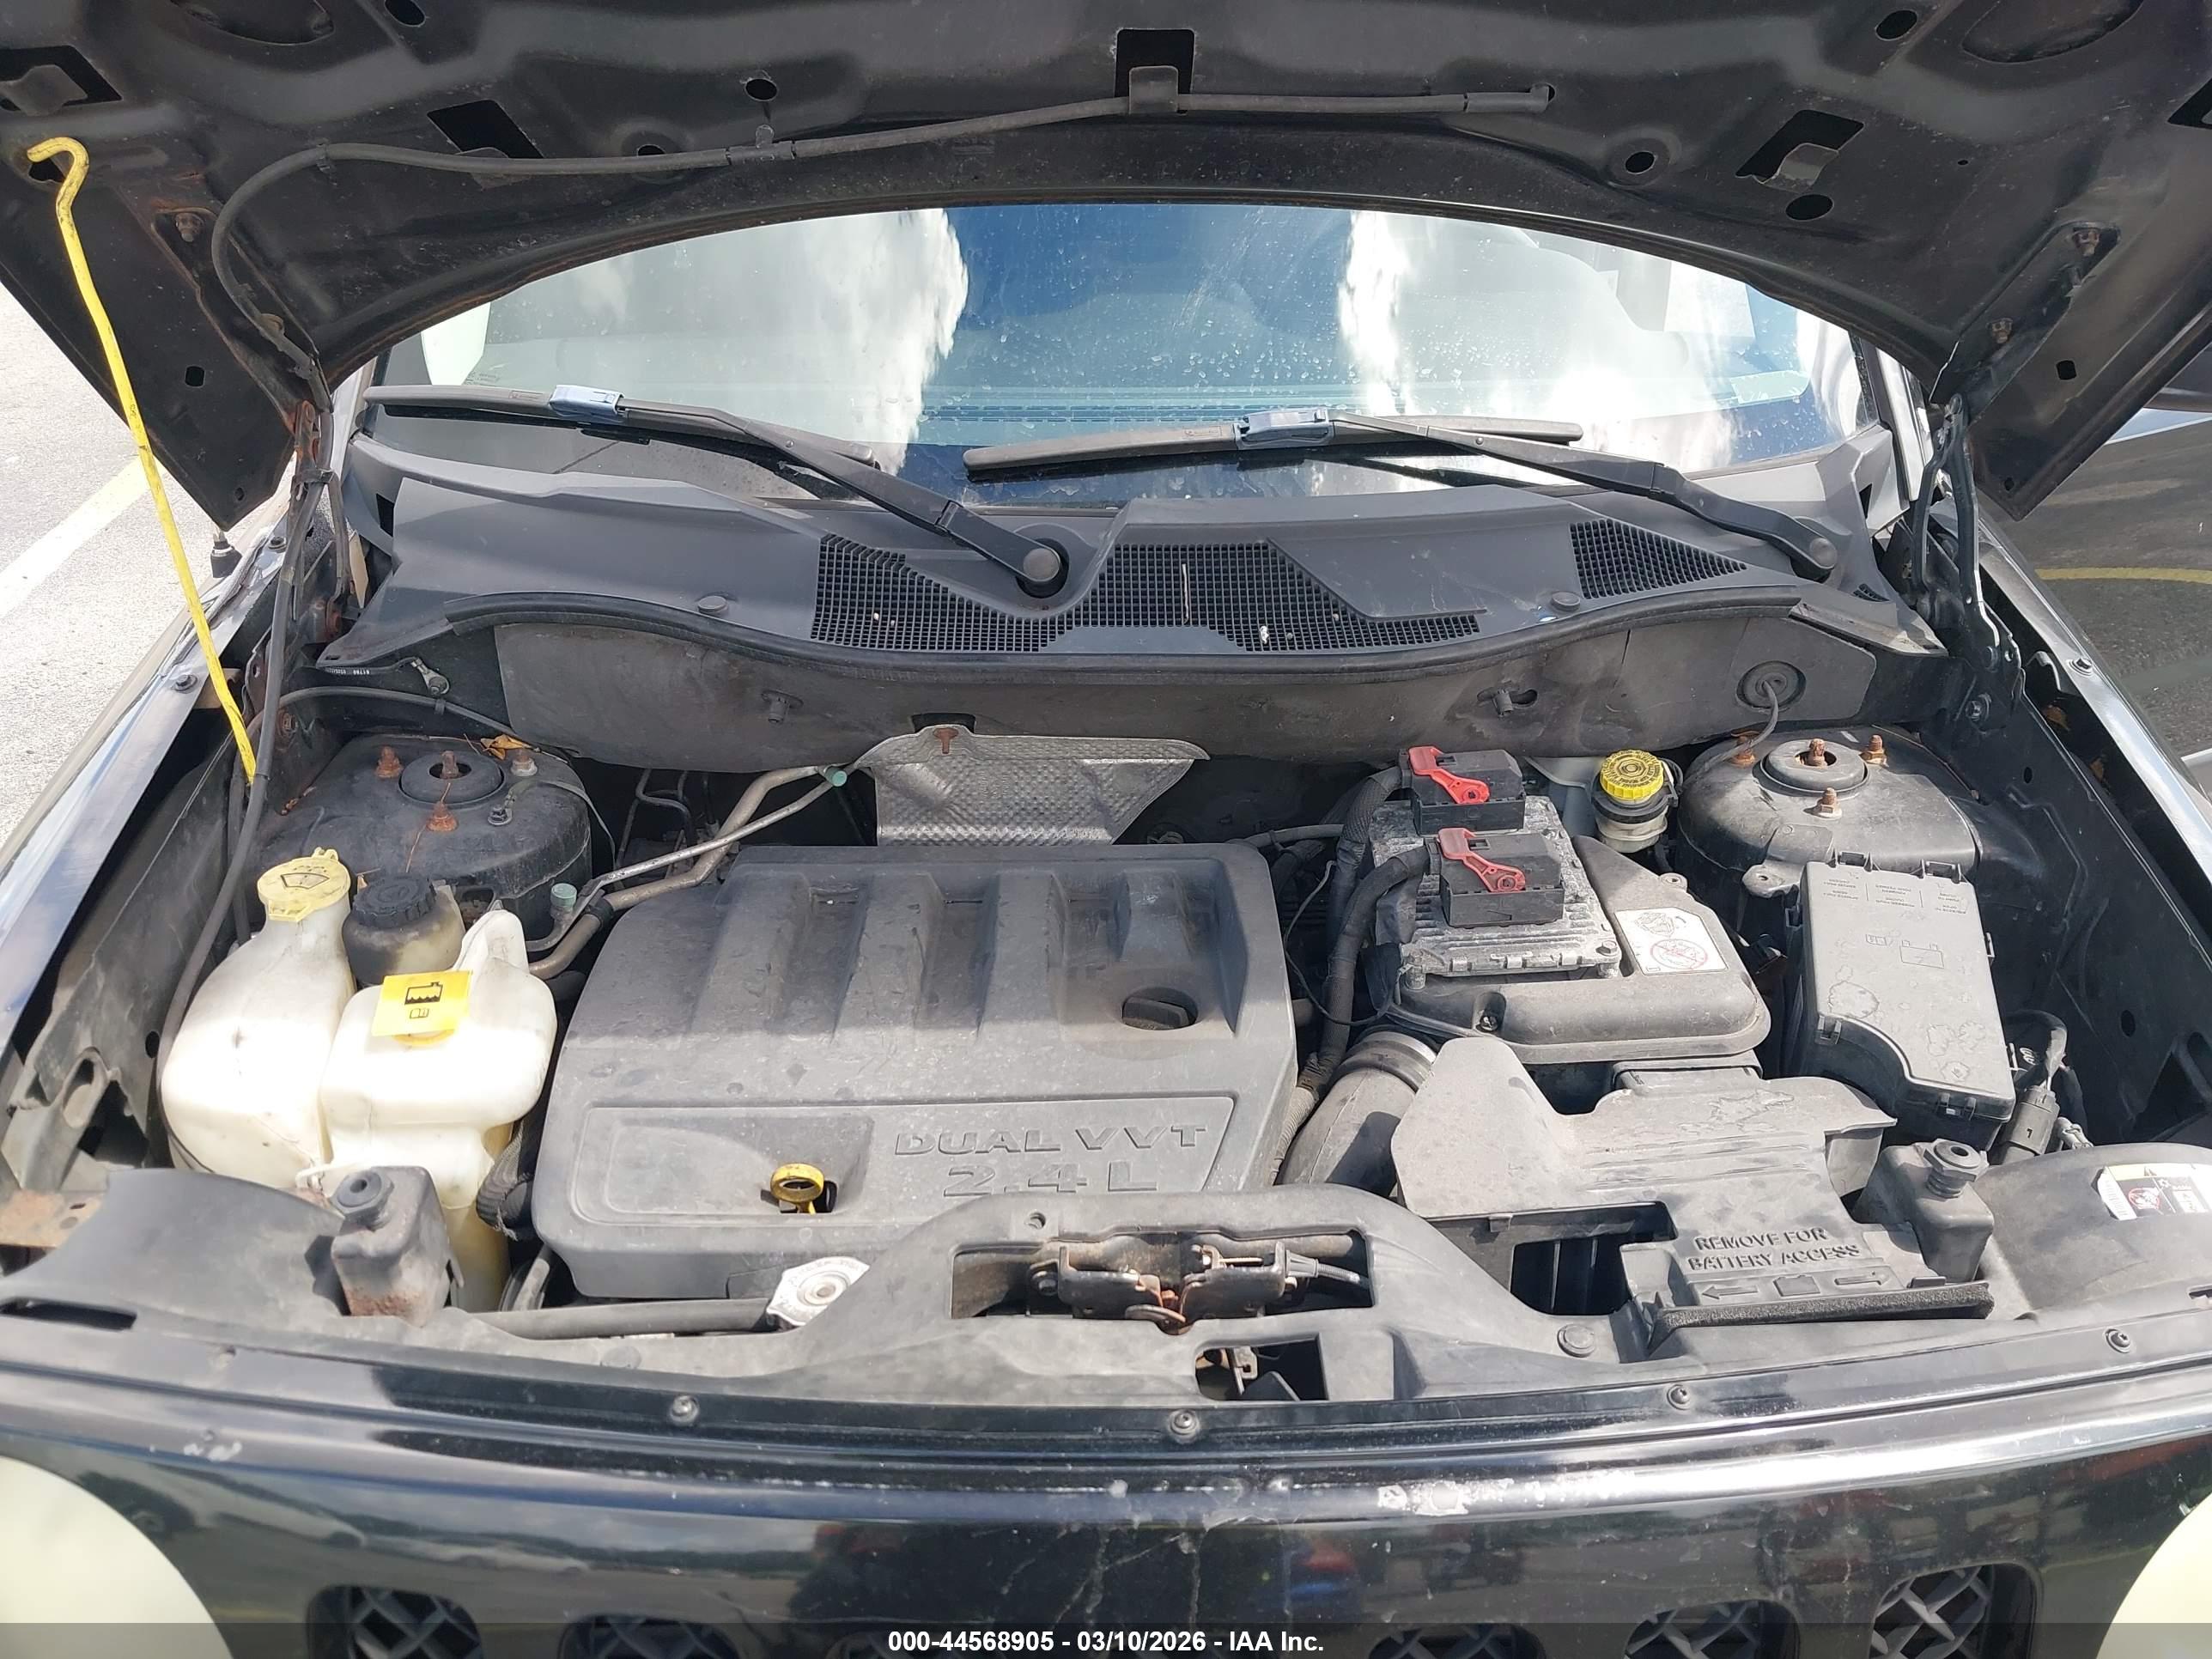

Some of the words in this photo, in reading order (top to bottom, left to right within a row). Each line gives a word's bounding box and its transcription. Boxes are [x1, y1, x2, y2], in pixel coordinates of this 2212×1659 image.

[895, 1128, 1061, 1155] DUAL
[1075, 1125, 1206, 1152] VVT
[944, 1160, 1158, 1197] 2.4L
[1694, 1233, 1781, 1251] REMOVE
[1784, 1227, 1829, 1244] FOR
[1687, 1252, 1773, 1271] BATTERY
[1781, 1244, 1861, 1265] ACCESS
